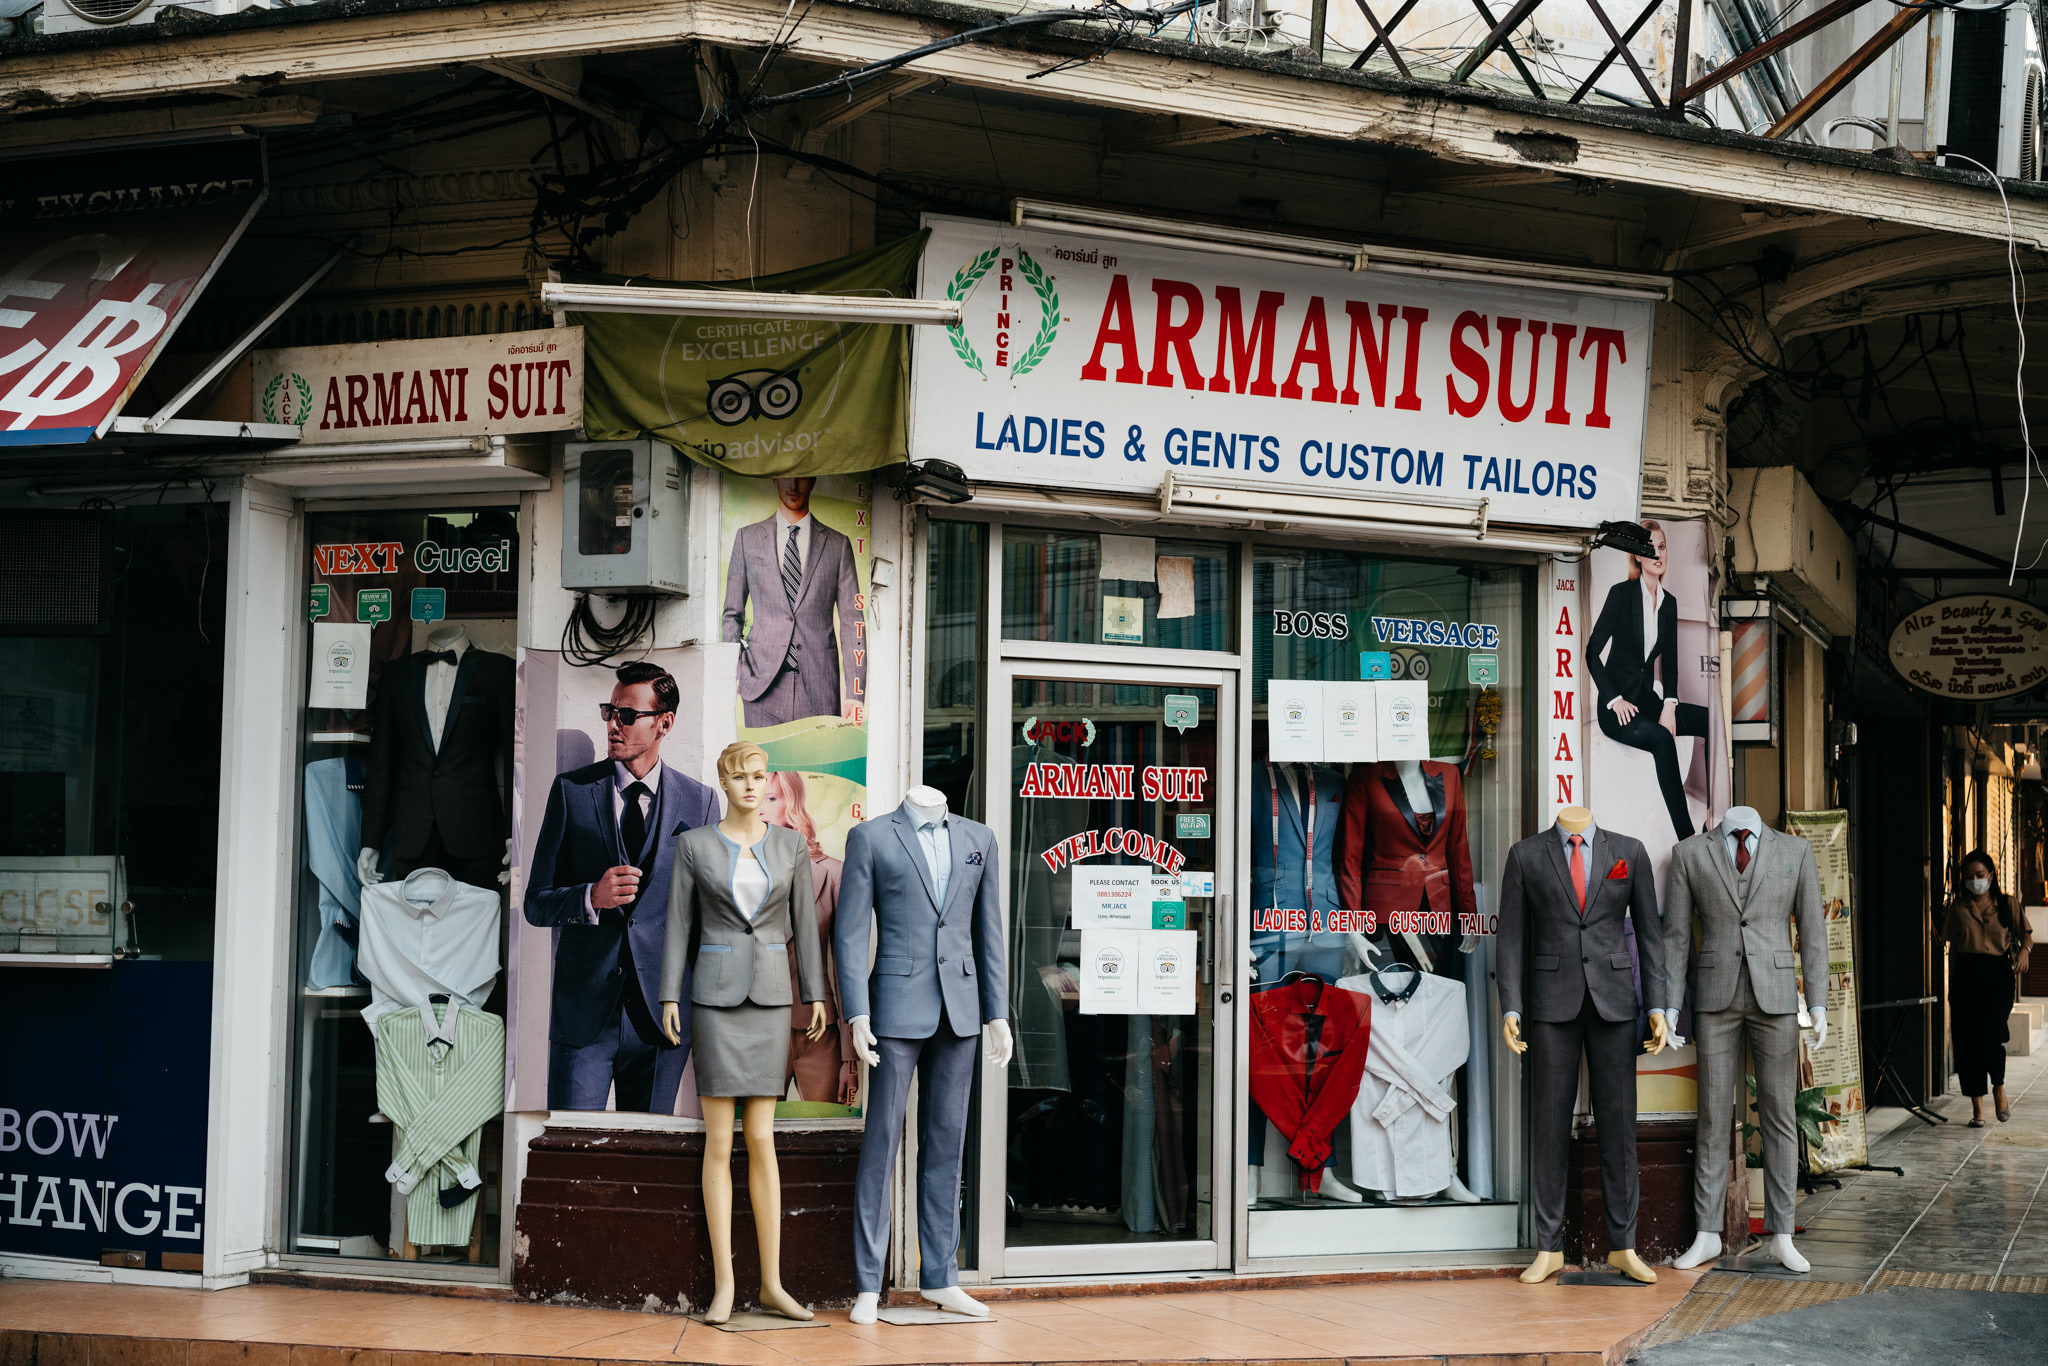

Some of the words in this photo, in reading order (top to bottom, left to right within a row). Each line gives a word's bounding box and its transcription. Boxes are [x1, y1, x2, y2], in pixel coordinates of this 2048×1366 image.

[697, 320, 792, 339] CERTIFICATE
[996, 257, 1014, 368] PRINCE
[1082, 273, 1429, 411] ARMANI
[1446, 310, 1627, 429] SUIT
[282, 378, 292, 425] JACK
[320, 367, 469, 430] ARMANI
[487, 359, 572, 420] SUIT
[975, 412, 1105, 459] LADIES
[1124, 424, 1146, 462] &
[1164, 427, 1280, 473] GENTS
[1300, 440, 1444, 487] CUSTOM
[1463, 454, 1597, 500] TAILORS
[313, 542, 404, 575] NEXT
[414, 539, 510, 573] Cucci
[1555, 578, 1575, 592] JACK
[1273, 609, 1349, 640] BOSS
[1371, 616, 1500, 650] VERSACE
[1941, 600, 1996, 625] Beauty
[2000, 606, 2013, 619] &
[2016, 611, 2048, 632] Spa
[853, 592, 866, 724] STYLE
[1553, 606, 1574, 804] ARMAN
[1027, 720, 1088, 743] JACK
[1020, 762, 1134, 799] ARMANI
[1142, 766, 1208, 802] SUIT
[1041, 827, 1186, 879] WELCOME
[0, 889, 107, 926] CLOSE
[1253, 908, 1307, 932] LADIES
[1311, 910, 1322, 932] &
[1327, 910, 1377, 934] GENTS
[1389, 910, 1451, 935] CUSTOM
[0, 1107, 119, 1159] BOW
